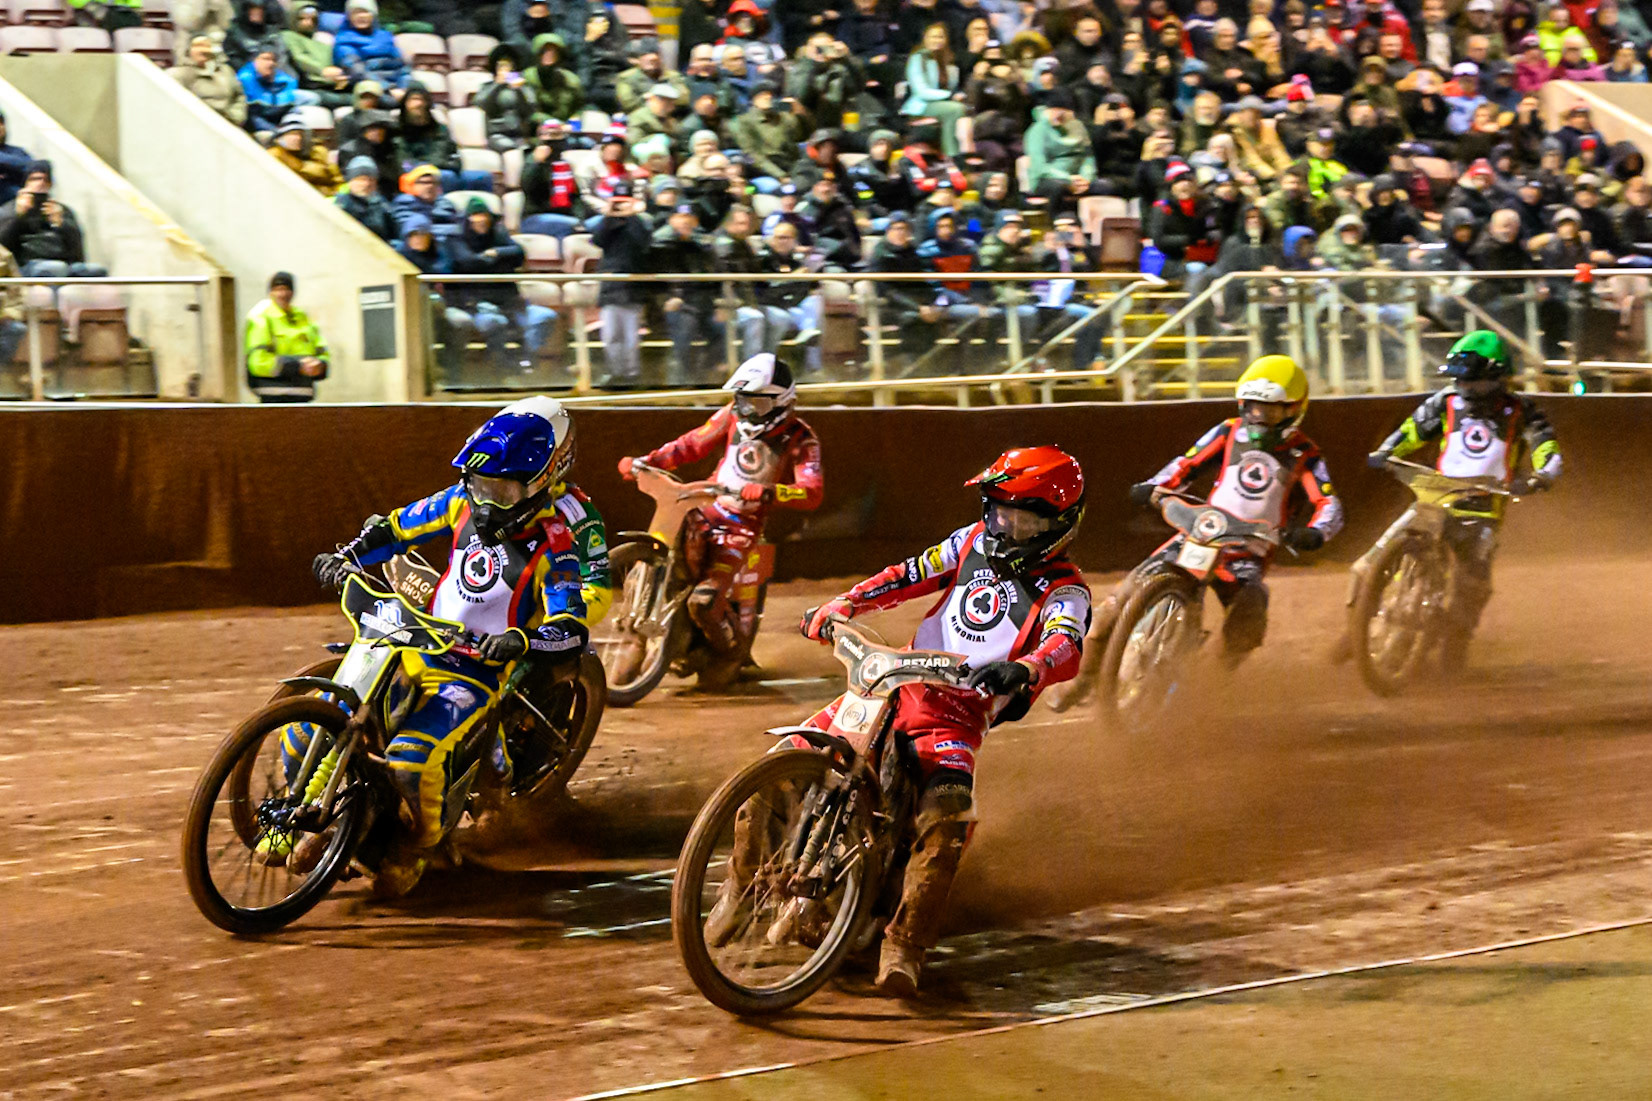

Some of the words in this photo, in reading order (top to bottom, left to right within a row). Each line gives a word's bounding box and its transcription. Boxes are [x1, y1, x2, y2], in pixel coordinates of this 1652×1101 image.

[527, 540, 538, 552] 4
[968, 579, 990, 592] BELLE
[1034, 576, 1050, 593] 12
[950, 615, 987, 643] MEMORIAL
